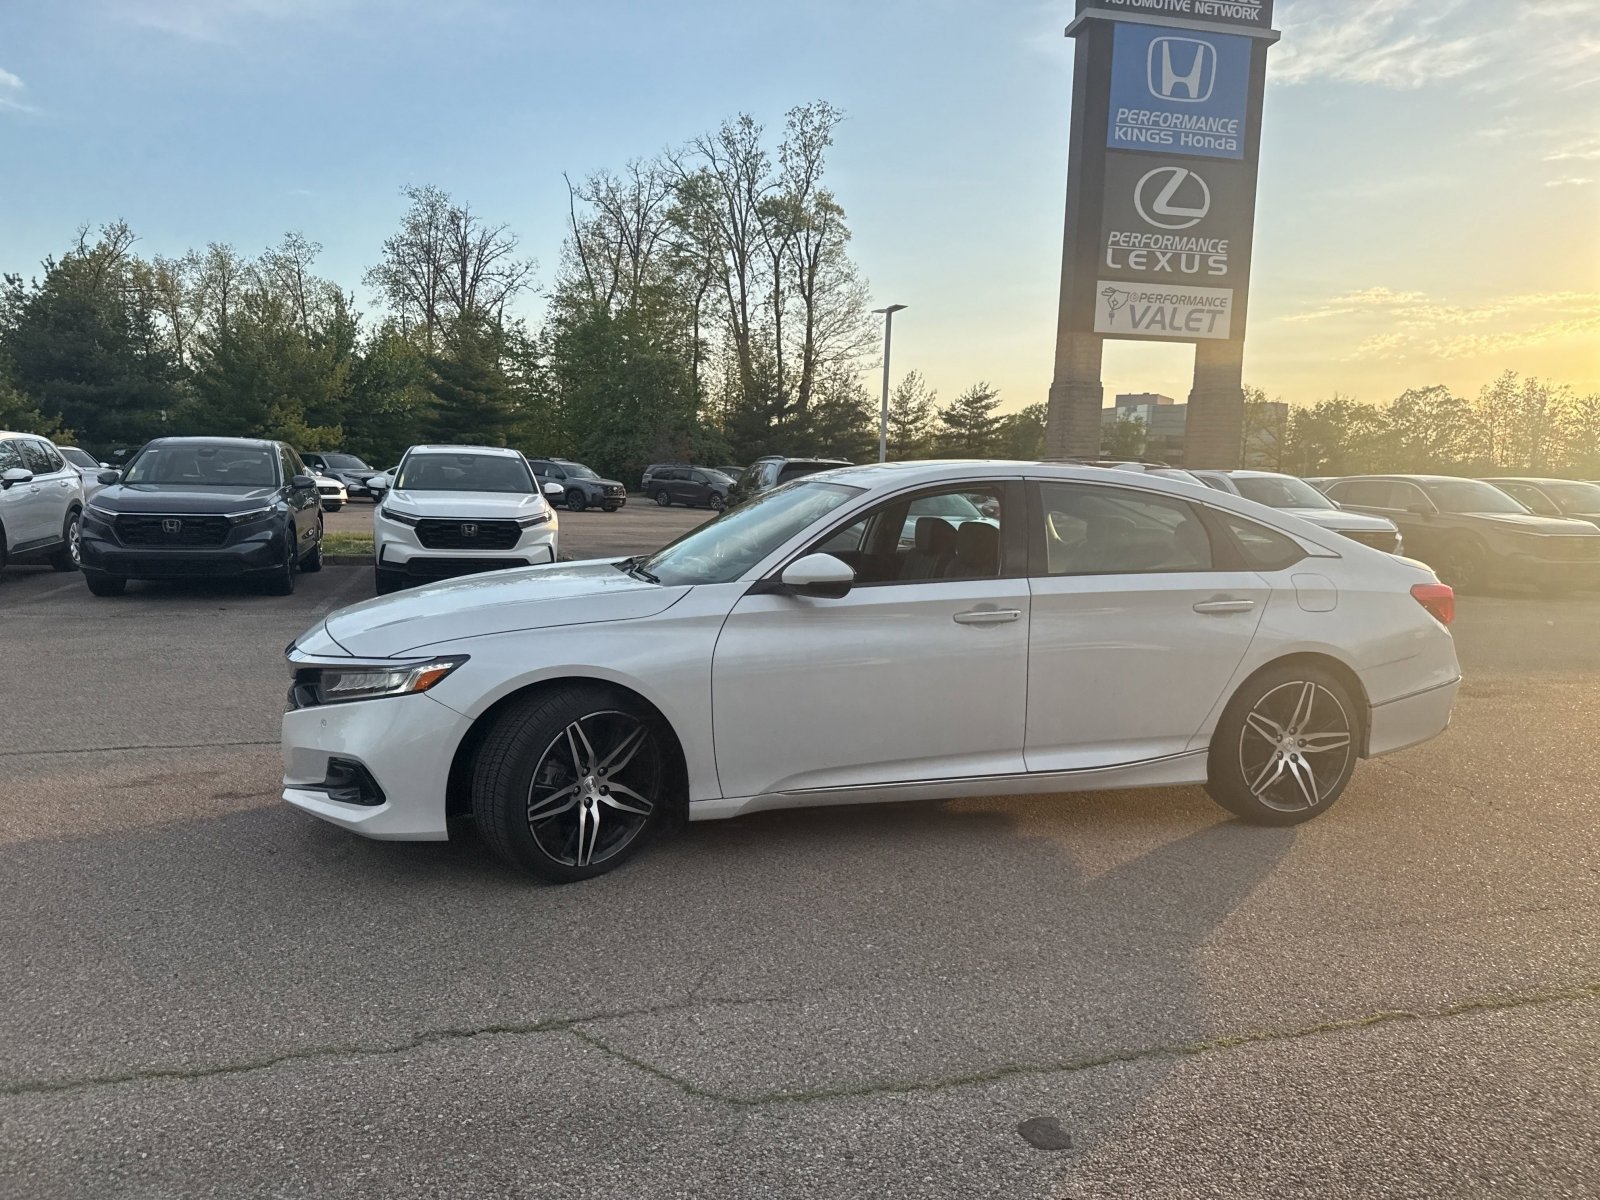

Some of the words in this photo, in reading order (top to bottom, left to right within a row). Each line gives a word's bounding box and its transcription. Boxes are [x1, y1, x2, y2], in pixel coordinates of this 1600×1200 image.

[1105, 0, 1190, 12] OMOTIVE
[1195, 1, 1260, 21] NETWORK
[1116, 108, 1238, 133] PERFORMANCE
[1114, 127, 1173, 145] KINGS
[1180, 133, 1236, 150] Honda
[1108, 231, 1228, 254] PERFORMANCE
[1106, 248, 1227, 275] LEXUS
[1139, 292, 1227, 308] PERFORMANCE
[1129, 304, 1224, 333] VALET
